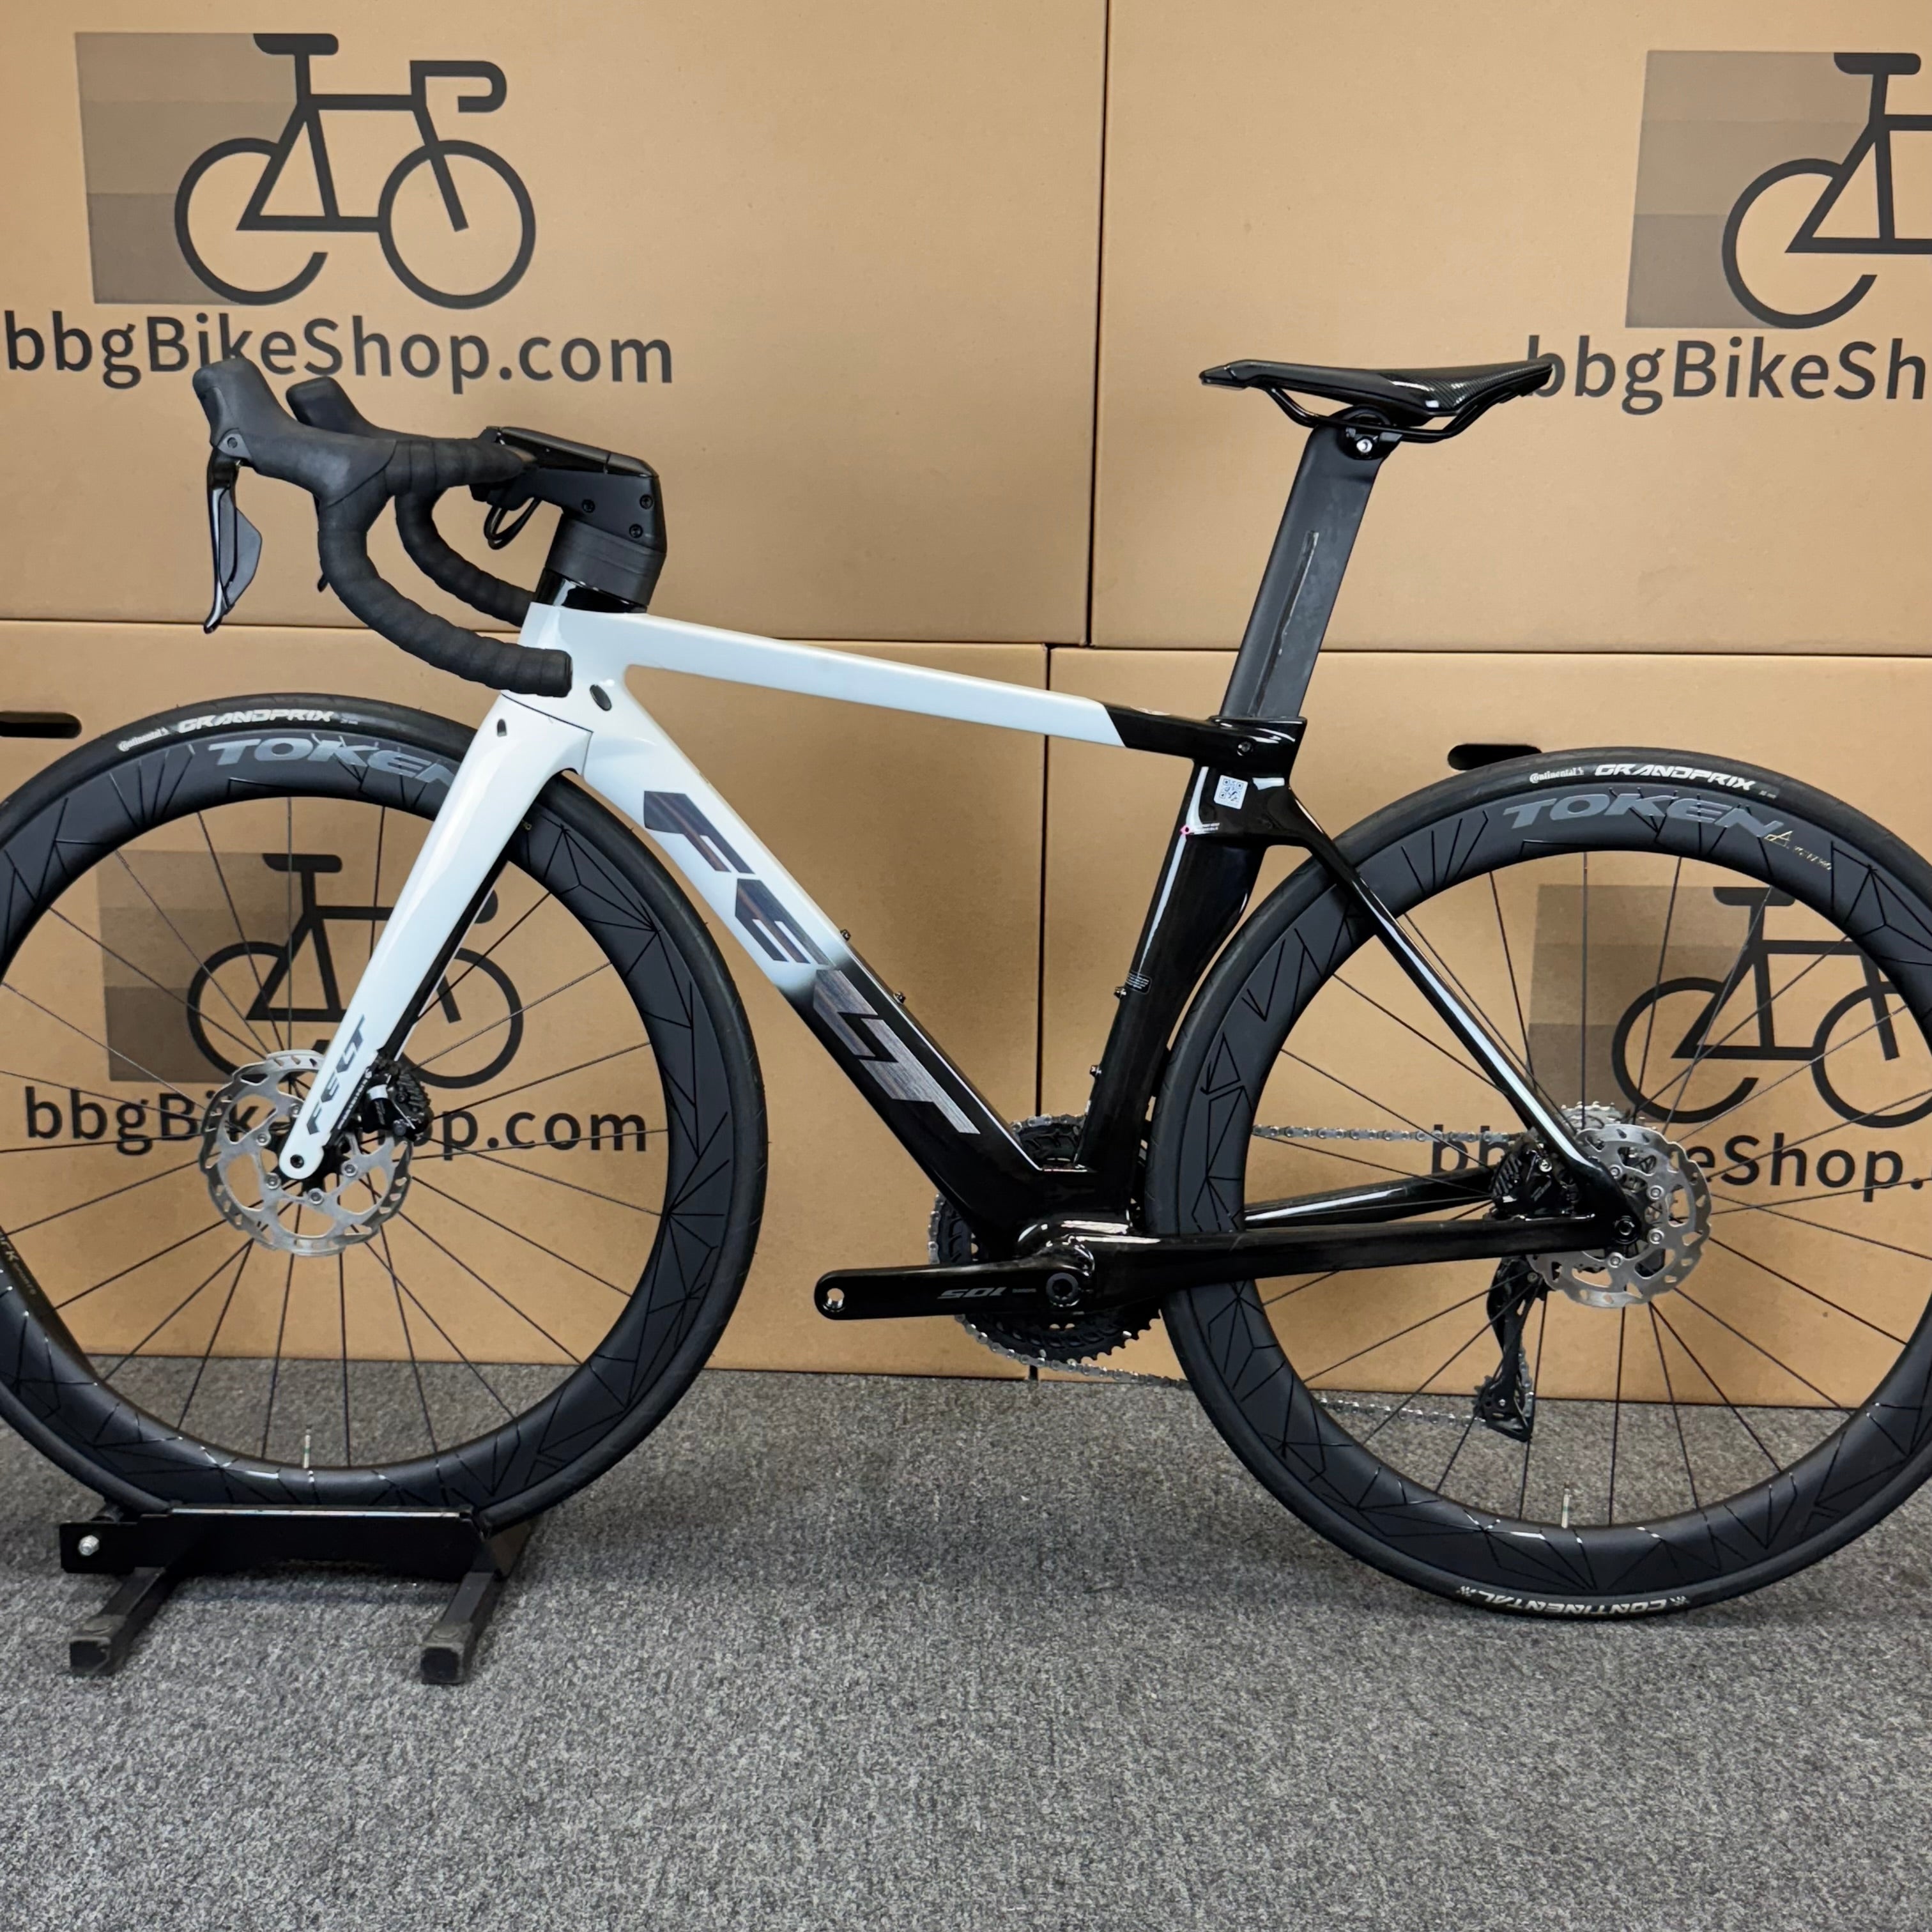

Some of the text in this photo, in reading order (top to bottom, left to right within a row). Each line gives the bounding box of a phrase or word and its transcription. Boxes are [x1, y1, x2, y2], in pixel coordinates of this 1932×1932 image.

[4, 310, 673, 394] bbgBikeShop.com
[177, 709, 335, 734] GRANDPRIX
[1595, 763, 1758, 791] GRANDPRIX
[1503, 793, 1784, 838] TOKEN
[643, 790, 981, 1135] FELT
[306, 1014, 365, 1135] FELT
[26, 1086, 647, 1161] bbgBkp.com
[937, 1286, 1008, 1300] 105
[1478, 1590, 1668, 1616] CONTINENTAL
